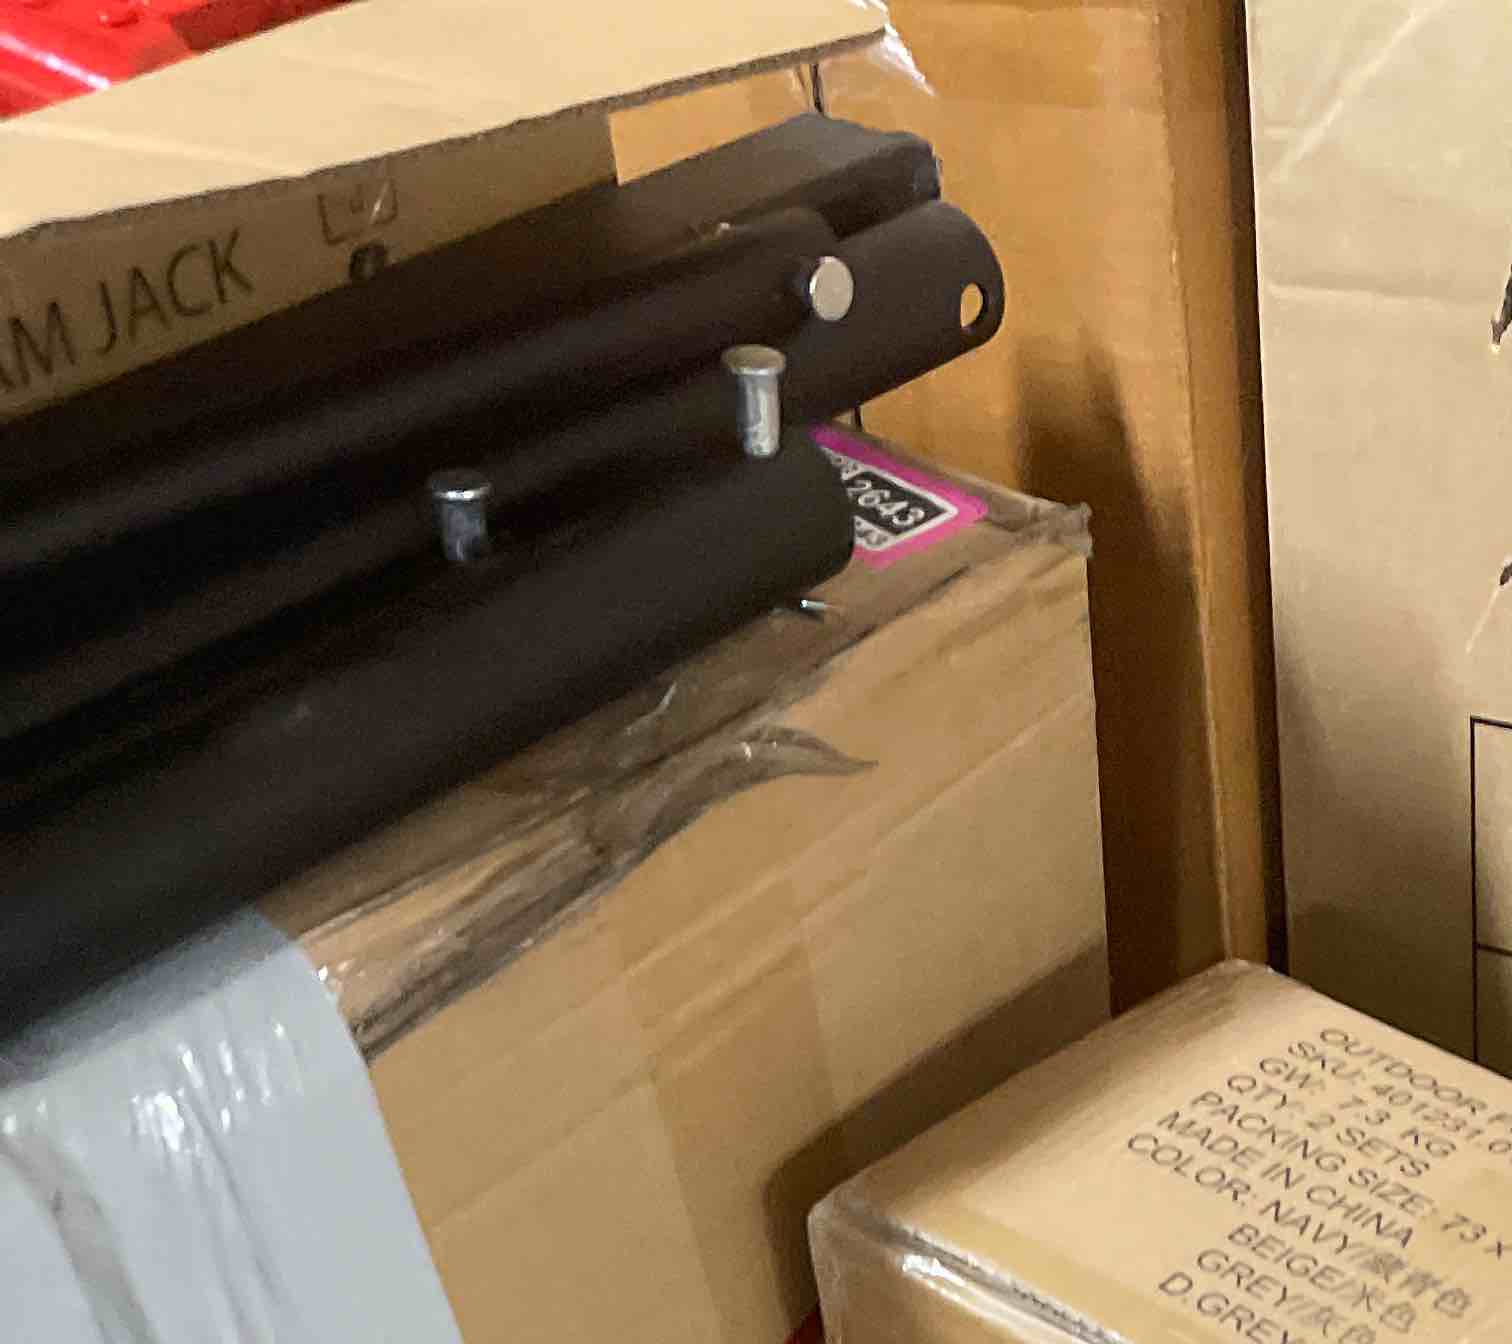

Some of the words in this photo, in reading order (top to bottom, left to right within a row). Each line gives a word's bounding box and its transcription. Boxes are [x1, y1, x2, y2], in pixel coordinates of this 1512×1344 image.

[96, 227, 254, 354] JACK
[1320, 1028, 1488, 1116] OUTDOOR
[1127, 1133, 1258, 1209] COLOR:
[1156, 1110, 1266, 1170] MADE
[1259, 1161, 1306, 1191] IN
[1306, 1184, 1413, 1249] CHINA
[1190, 1090, 1347, 1173] PACKING
[1441, 1212, 1488, 1243] 73
[1305, 1112, 1336, 1132] 2
[1336, 1126, 1430, 1178] SETS
[1400, 1126, 1457, 1158] KG
